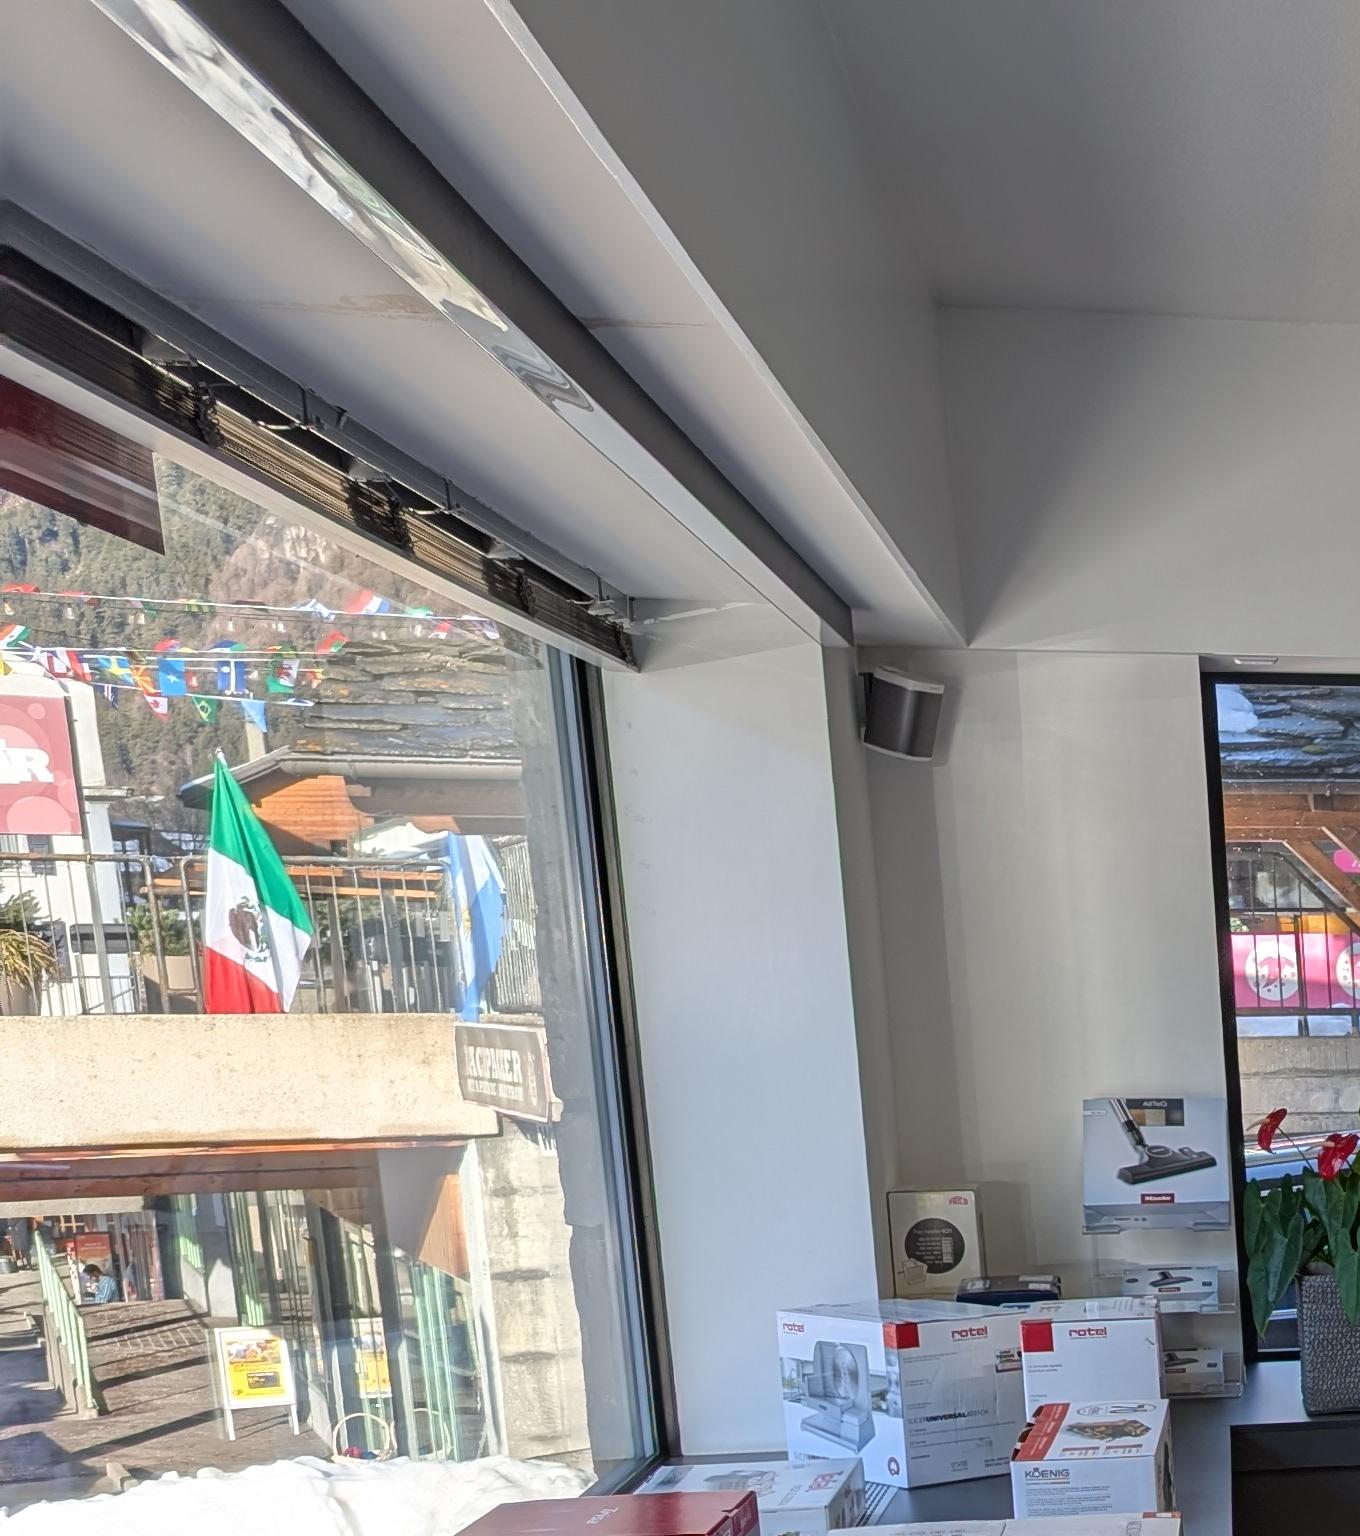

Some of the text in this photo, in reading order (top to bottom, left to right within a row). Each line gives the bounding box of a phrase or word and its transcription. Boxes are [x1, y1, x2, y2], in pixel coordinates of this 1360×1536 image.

[783, 1322, 805, 1333] rotel
[951, 1326, 988, 1339] rotel
[1069, 1327, 1107, 1337] rotel
